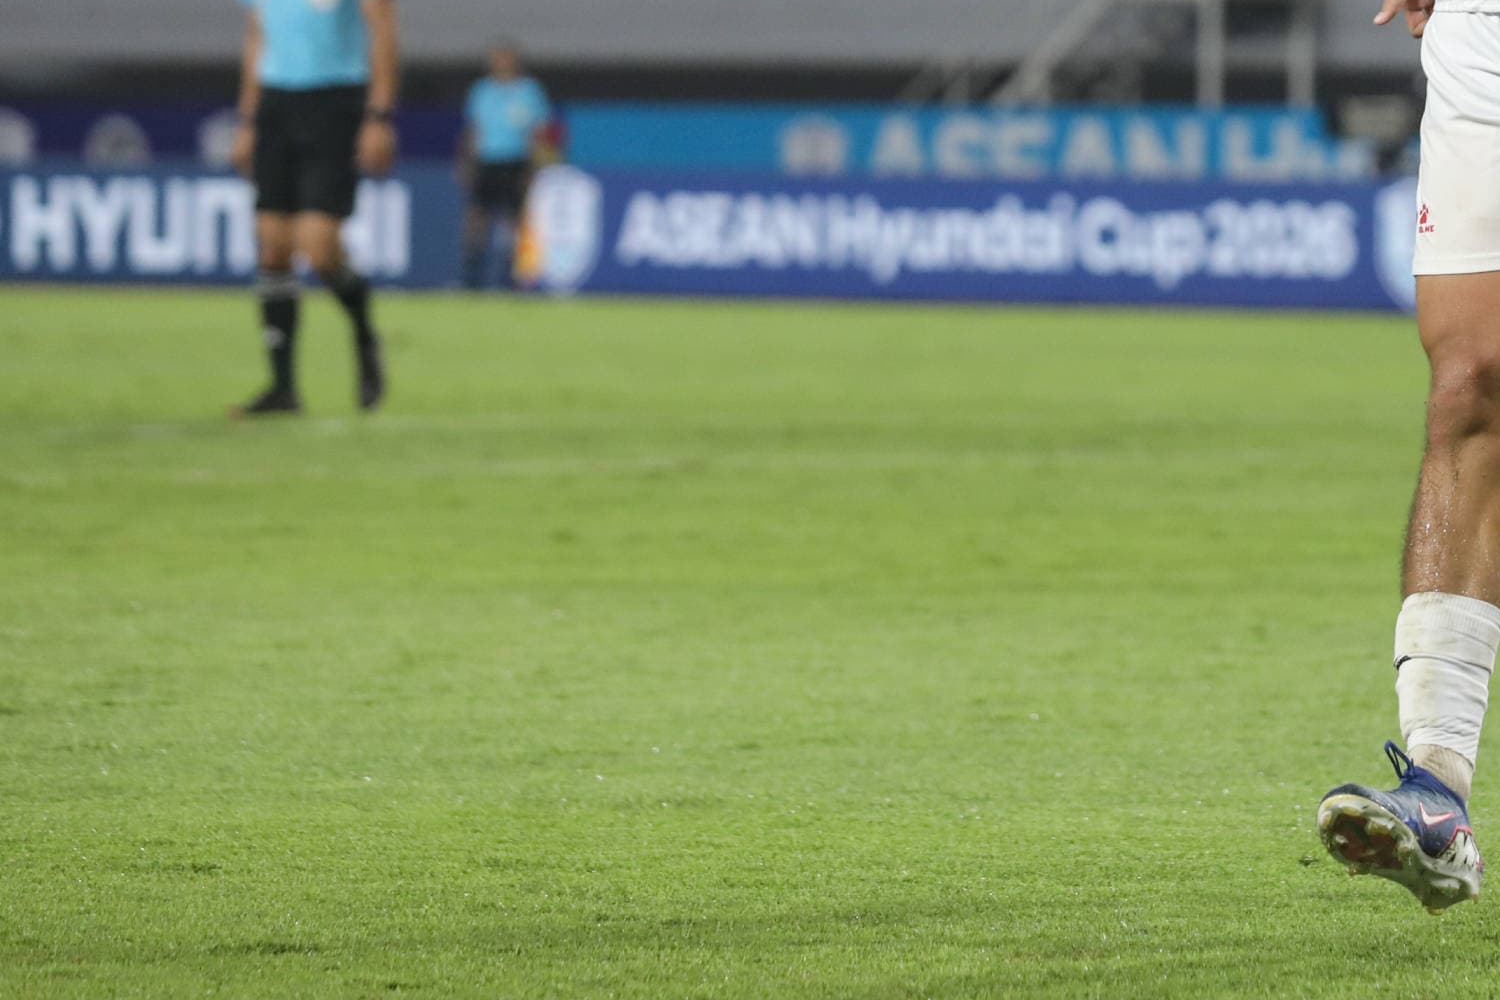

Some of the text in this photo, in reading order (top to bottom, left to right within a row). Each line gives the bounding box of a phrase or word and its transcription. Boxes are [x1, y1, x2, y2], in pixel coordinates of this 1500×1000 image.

[11, 174, 411, 273] HYUNI
[615, 190, 1358, 290] ASEAN Hyundai Cup 2026
